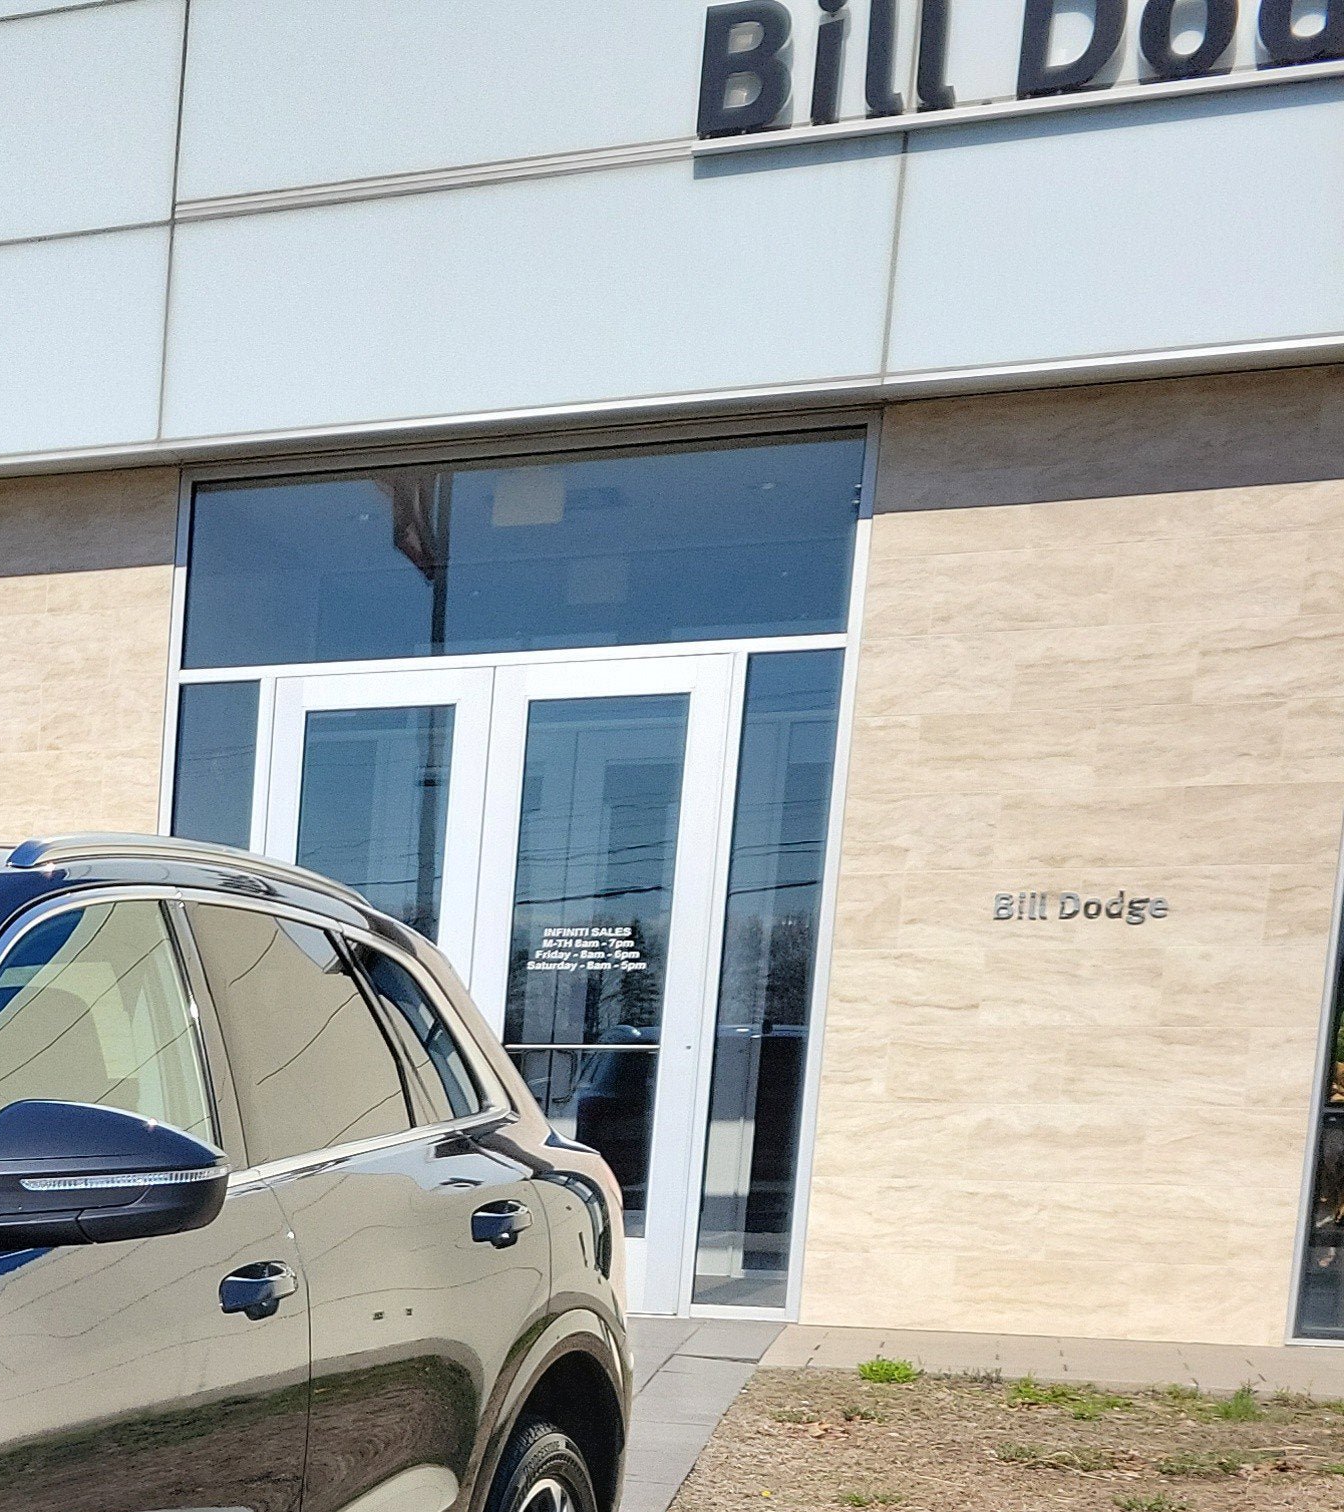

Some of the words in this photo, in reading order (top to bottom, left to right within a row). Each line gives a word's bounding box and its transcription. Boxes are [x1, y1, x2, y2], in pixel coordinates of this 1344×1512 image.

[696, 0, 955, 139] Bill
[993, 892, 1048, 920] Bill
[1058, 890, 1170, 925] Dodge
[543, 928, 590, 937] INFINITI
[591, 927, 633, 936] SALES
[542, 939, 573, 948] M-TH
[574, 939, 600, 948] 8am
[608, 938, 635, 949] 7pm
[535, 950, 572, 960] Friday
[579, 950, 605, 959] 8am
[614, 949, 641, 960] 6pm
[527, 961, 579, 972] Saturday
[586, 961, 612, 970] 8am
[620, 960, 647, 972] 5pm
